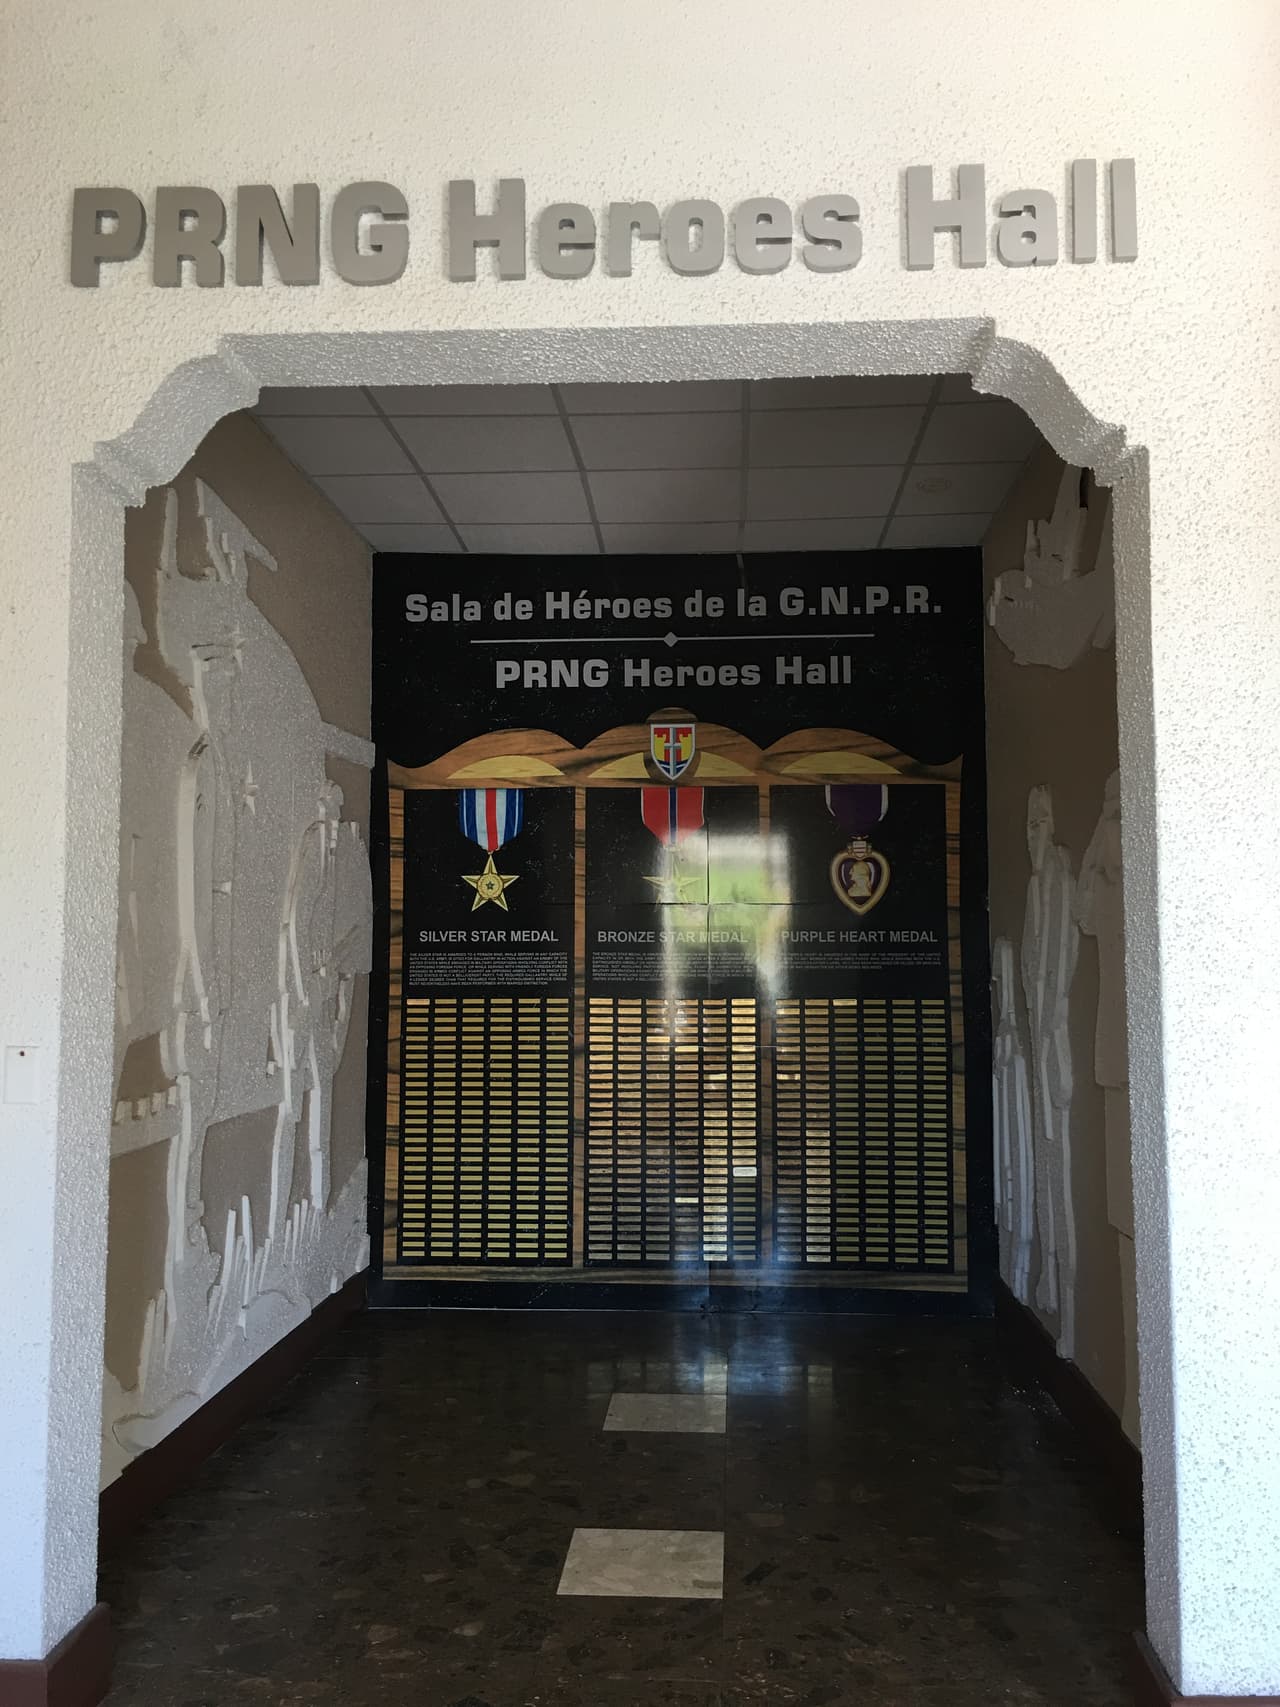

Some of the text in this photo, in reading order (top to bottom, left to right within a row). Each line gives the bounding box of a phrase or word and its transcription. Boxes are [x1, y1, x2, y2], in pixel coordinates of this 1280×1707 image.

[70, 158, 1138, 288] PRNG Heroes Hall
[405, 585, 942, 622] Sala de Héroes de la G.N.P.R.
[496, 655, 851, 689] PRNG Heroes Hall
[419, 930, 559, 943] SILVER STAR MEDAL
[597, 931, 749, 944] BRONZE STAR MEDAL
[781, 930, 939, 943] PURPLE HEART MEDAL
